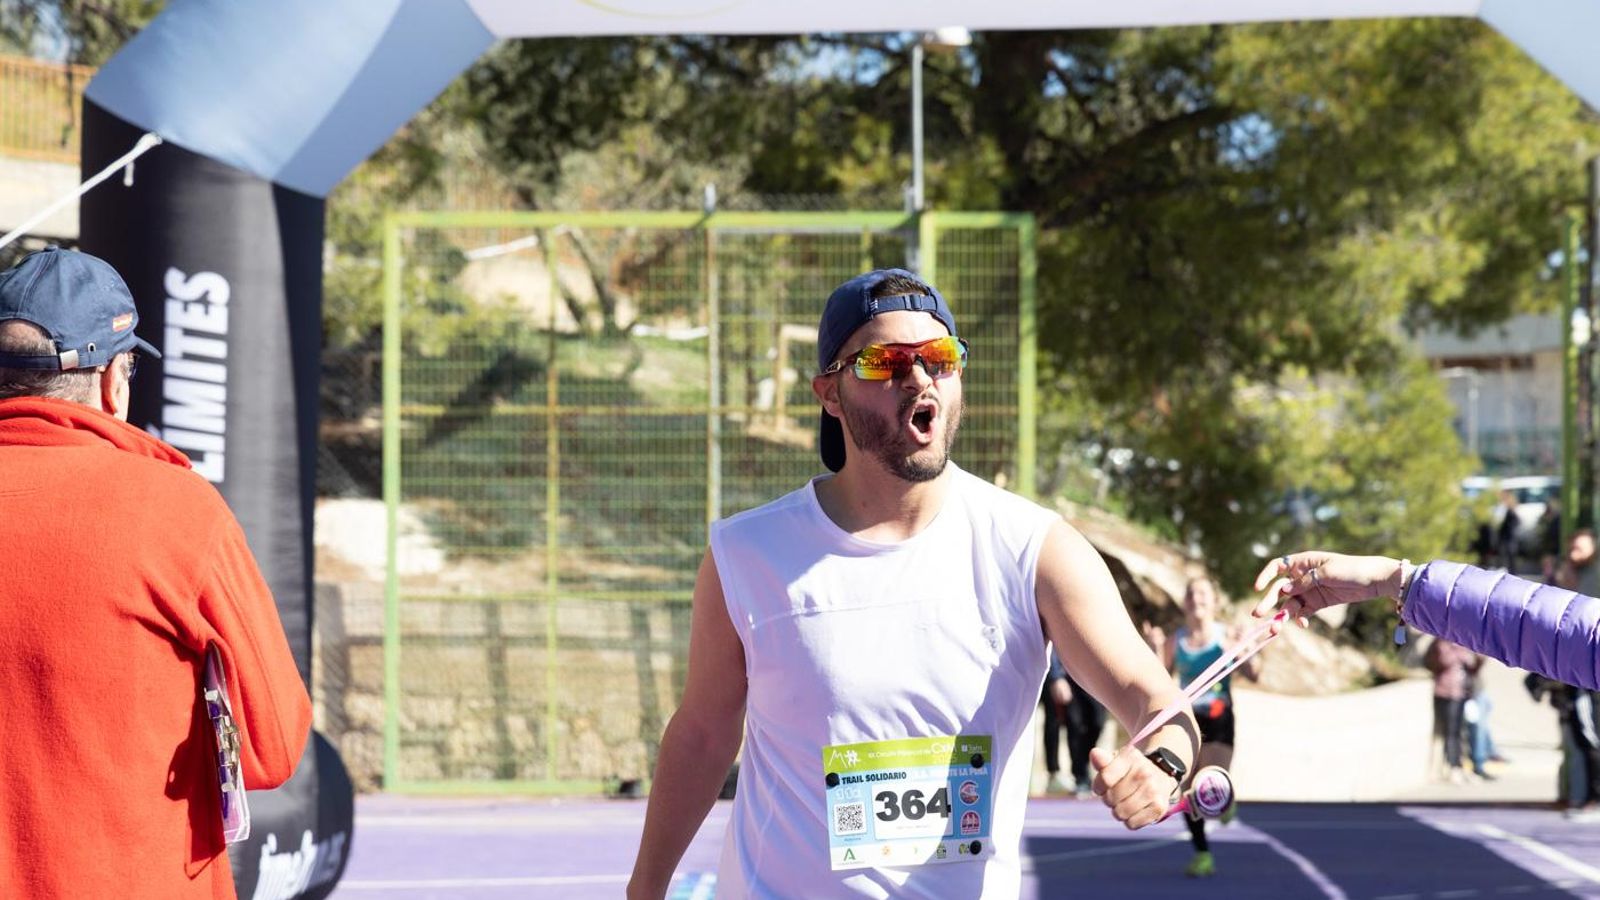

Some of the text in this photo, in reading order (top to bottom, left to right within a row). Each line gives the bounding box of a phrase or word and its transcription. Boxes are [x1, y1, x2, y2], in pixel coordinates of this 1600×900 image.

[841, 774, 864, 784] TRAIL
[865, 772, 907, 782] SOLIDARIO
[875, 788, 951, 822] 364
